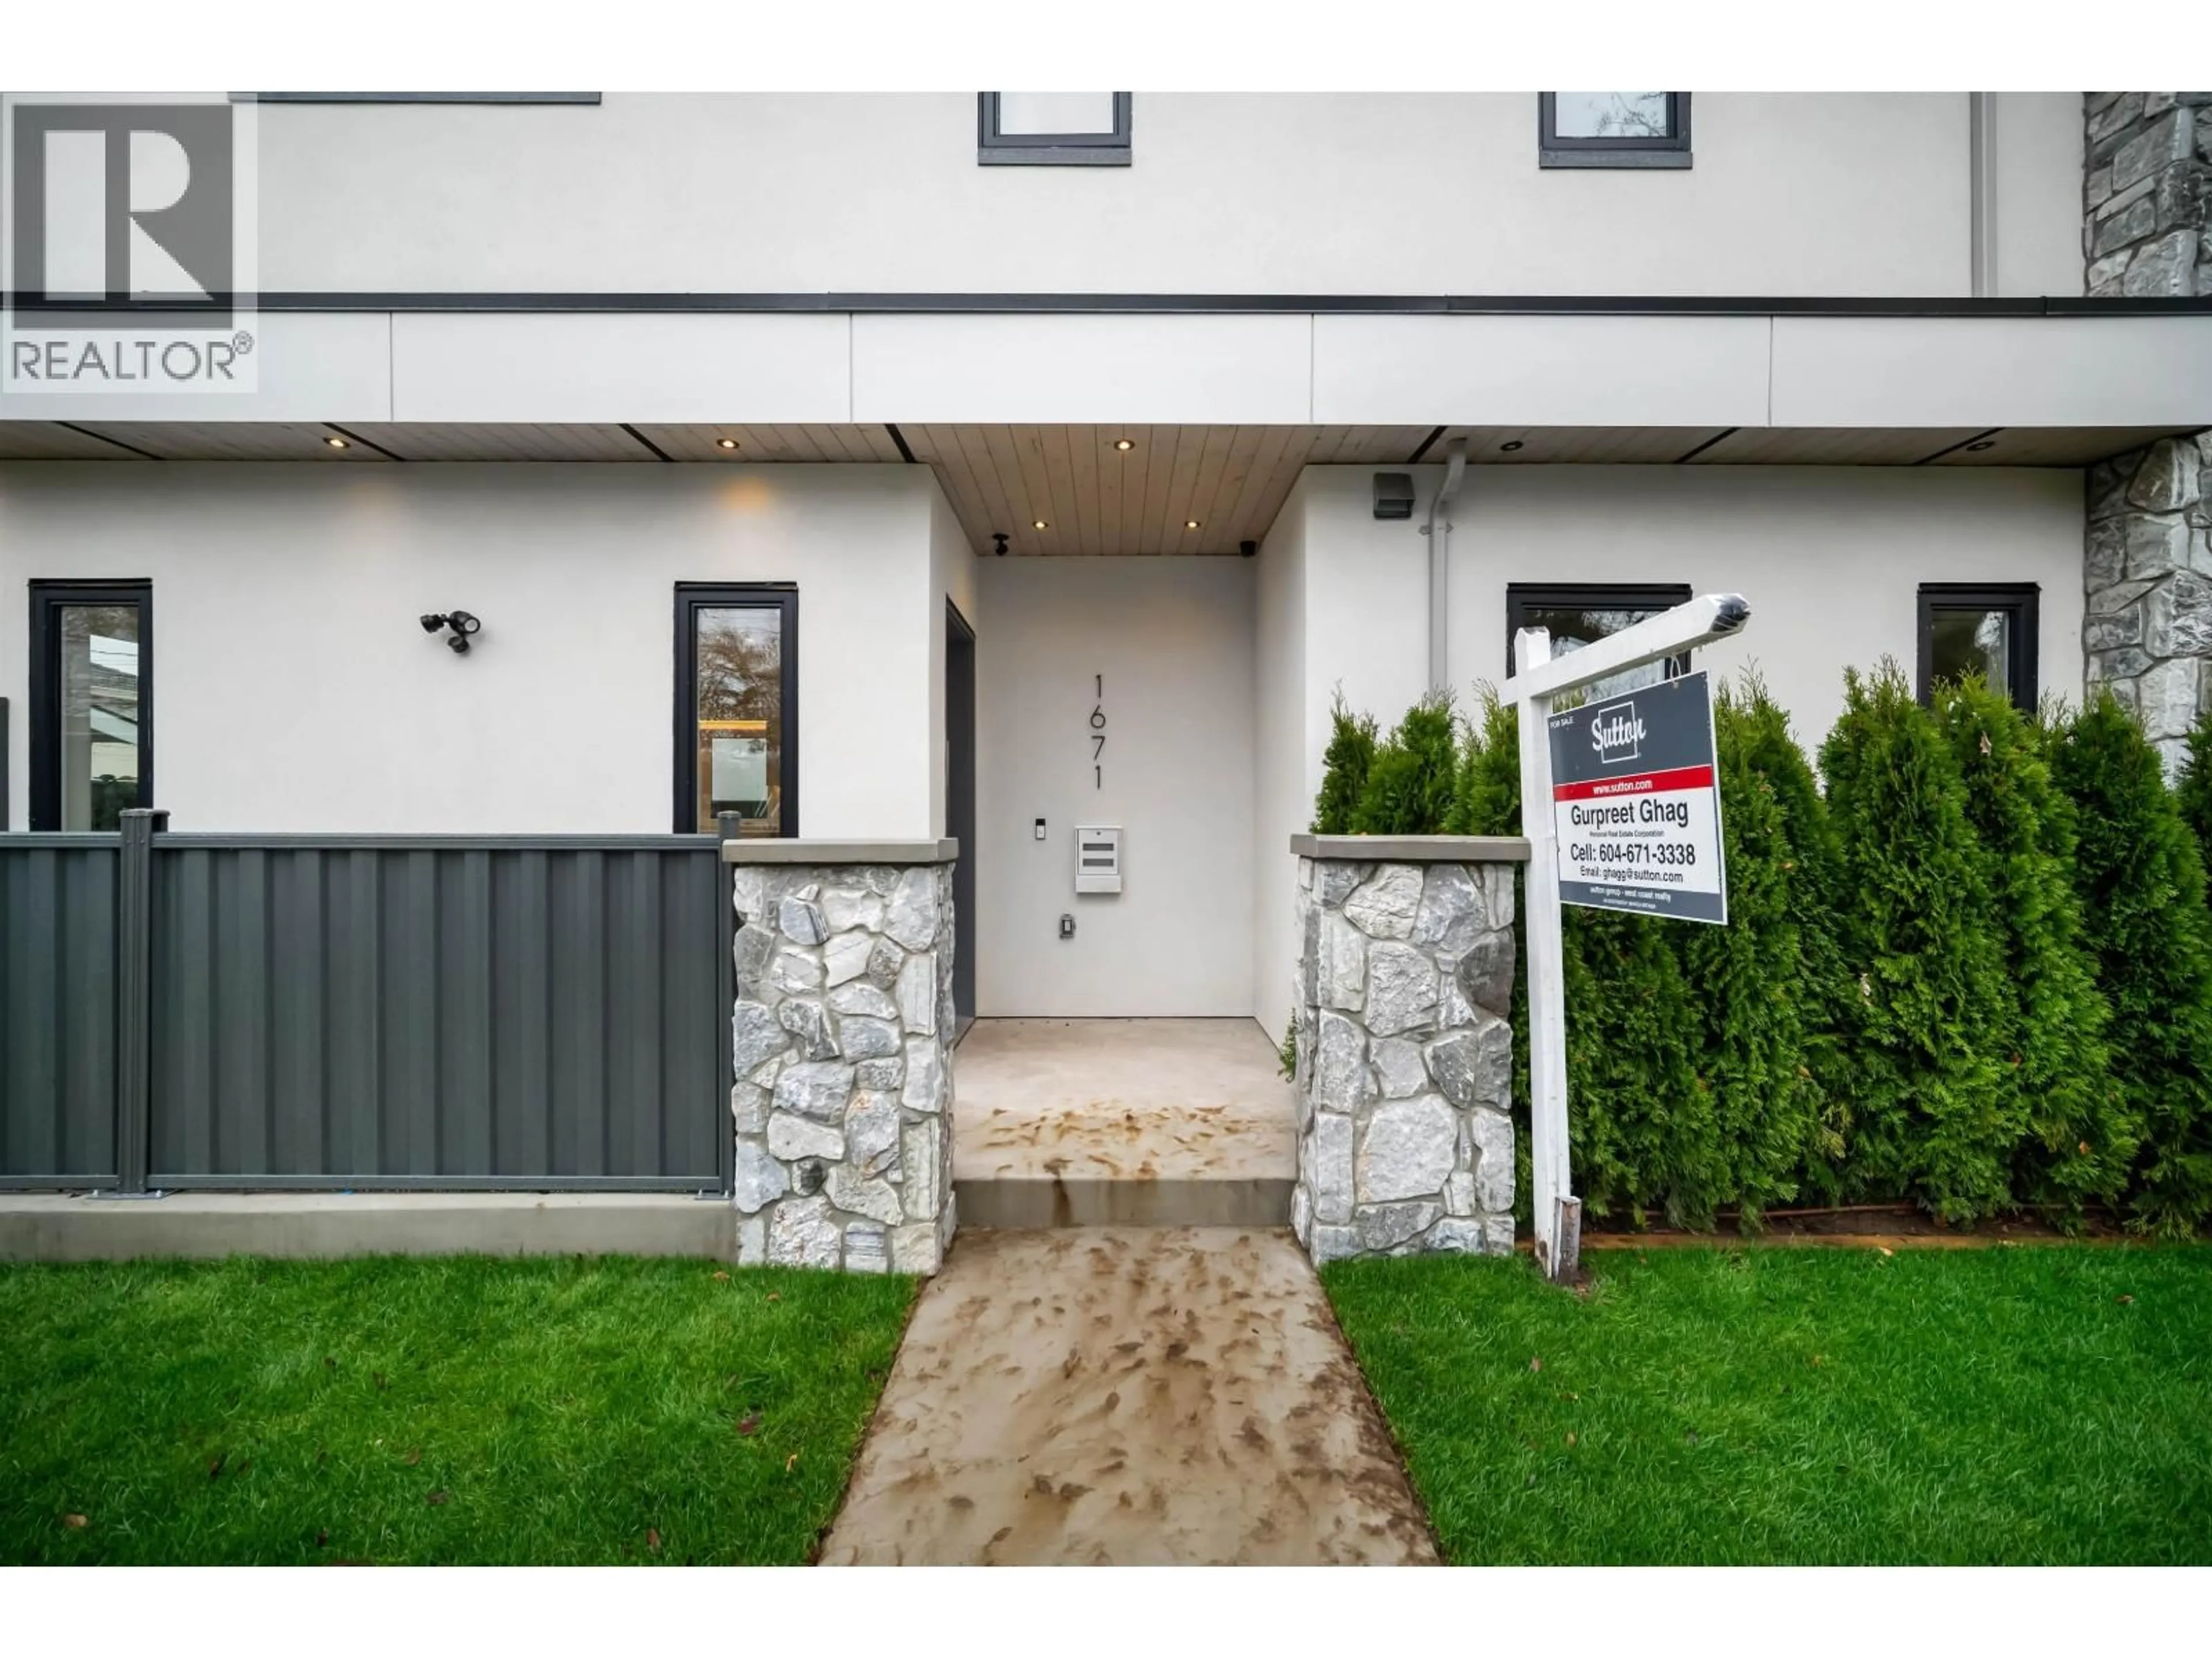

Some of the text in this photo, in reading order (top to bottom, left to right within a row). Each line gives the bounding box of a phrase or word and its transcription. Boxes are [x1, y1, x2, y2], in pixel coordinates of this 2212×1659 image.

[1090, 674, 1106, 790] 1671
[1550, 716, 1574, 729] FOR SALE
[1591, 716, 1646, 751] Sutton
[1593, 779, 1653, 794] www.sutton.com
[1571, 798, 1689, 830] Gurpreet Ghag
[1570, 843, 1695, 865] Cell: 604-671-3338
[1580, 865, 1683, 883] Email: ghagg@sutton.com
